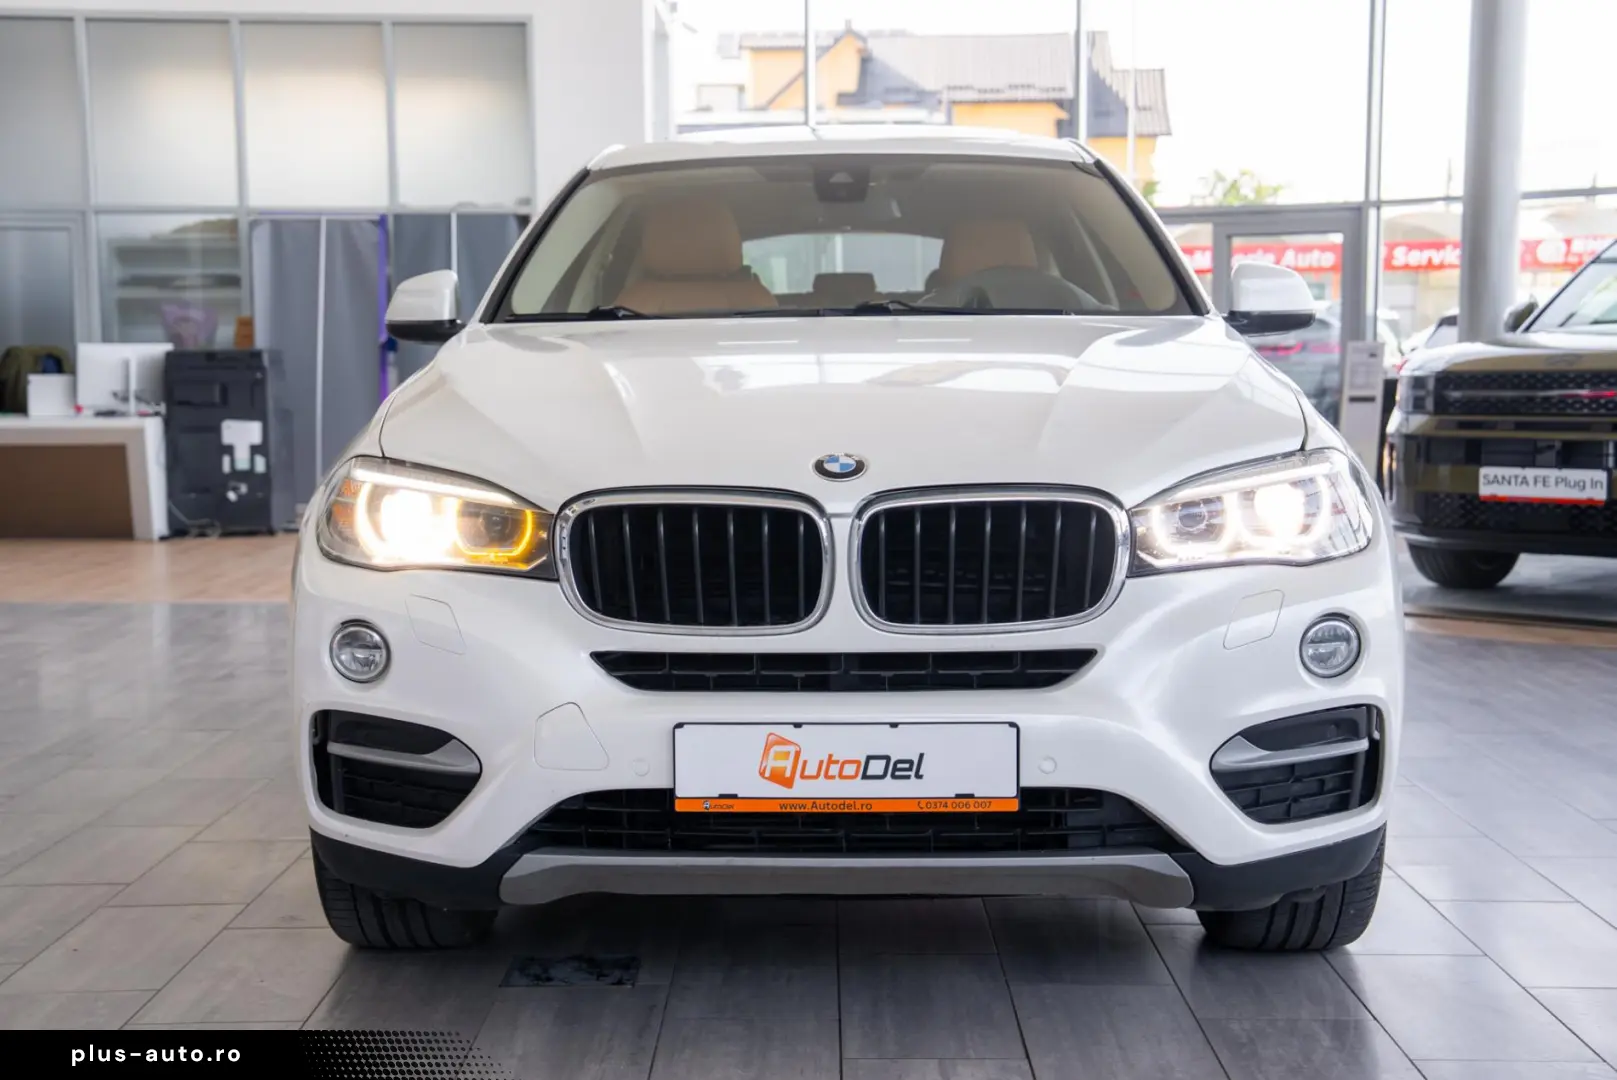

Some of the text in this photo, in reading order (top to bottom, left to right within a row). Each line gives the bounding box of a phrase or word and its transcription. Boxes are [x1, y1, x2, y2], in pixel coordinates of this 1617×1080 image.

[1280, 247, 1335, 268] Auto
[1482, 473, 1604, 492] SANTA FE Plug In
[760, 740, 925, 783] AutoDel
[779, 801, 872, 811] www.Autodel.ro
[926, 800, 992, 810] 0374 006 007
